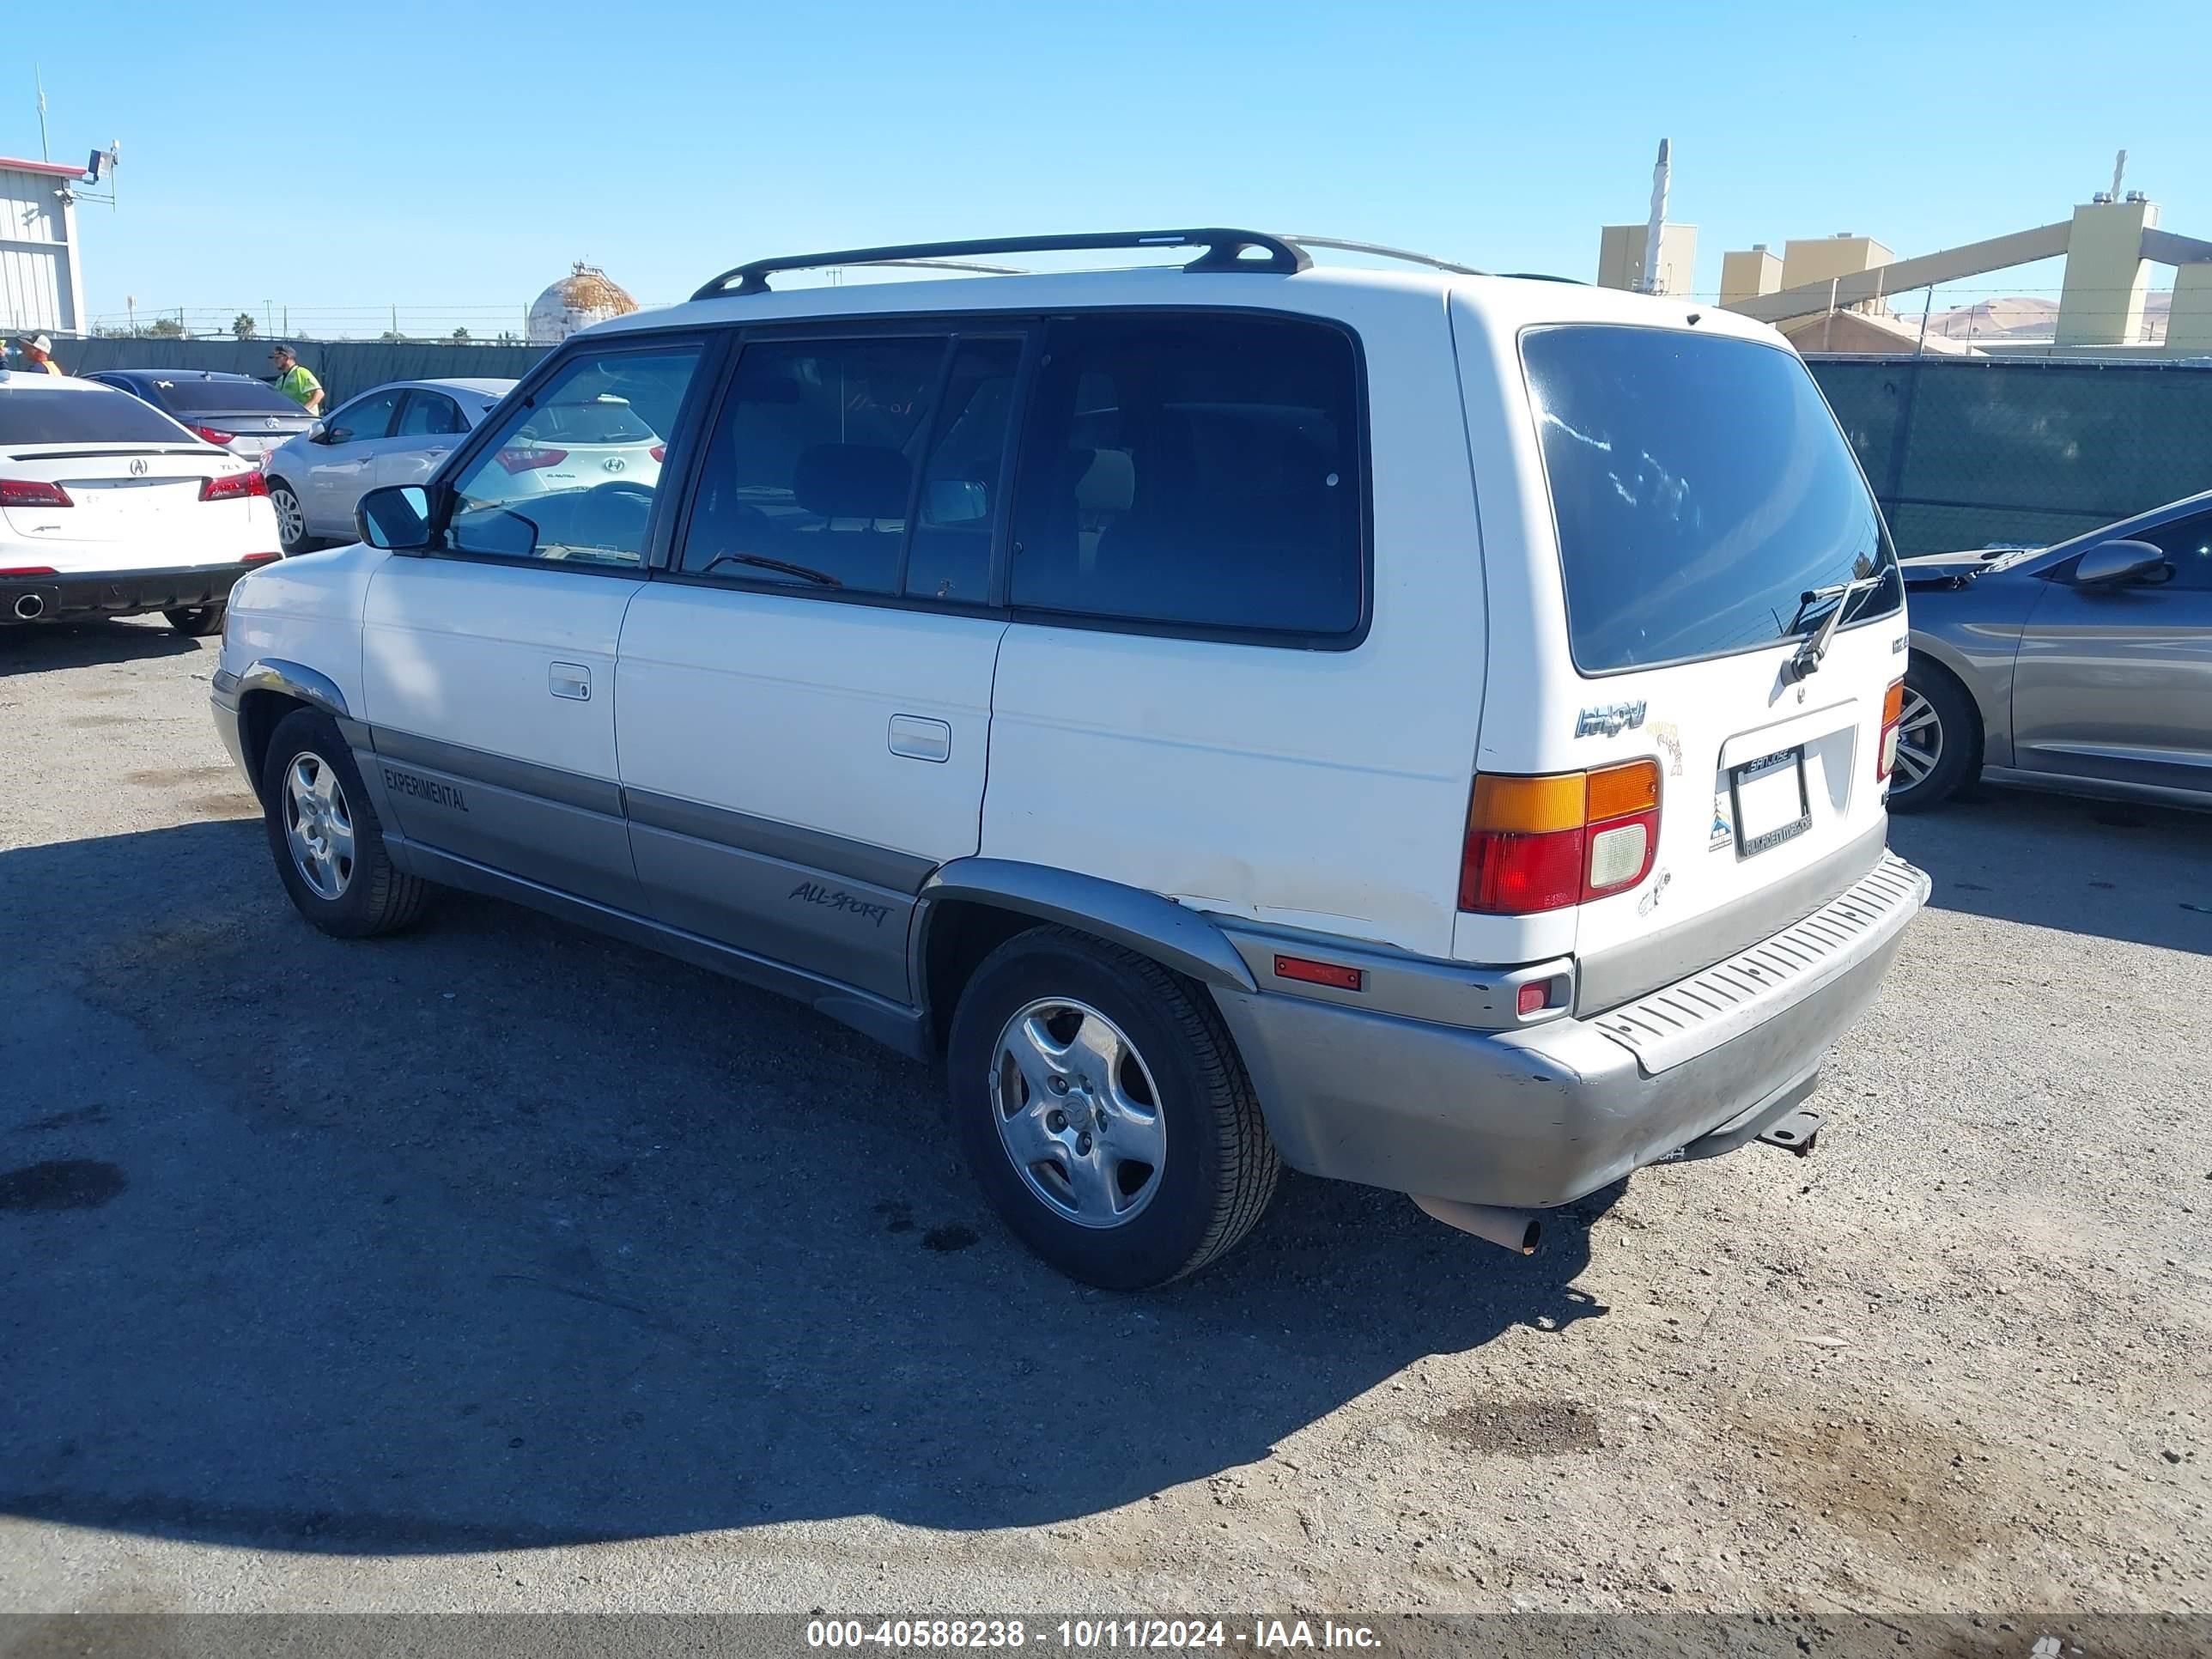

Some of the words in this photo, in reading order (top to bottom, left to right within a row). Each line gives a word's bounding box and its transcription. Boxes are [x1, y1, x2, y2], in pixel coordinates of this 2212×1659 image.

[1768, 749, 1790, 767] JOSE
[384, 769, 469, 812] EXPERIMENTAL
[788, 881, 894, 927] ALL-SPORT
